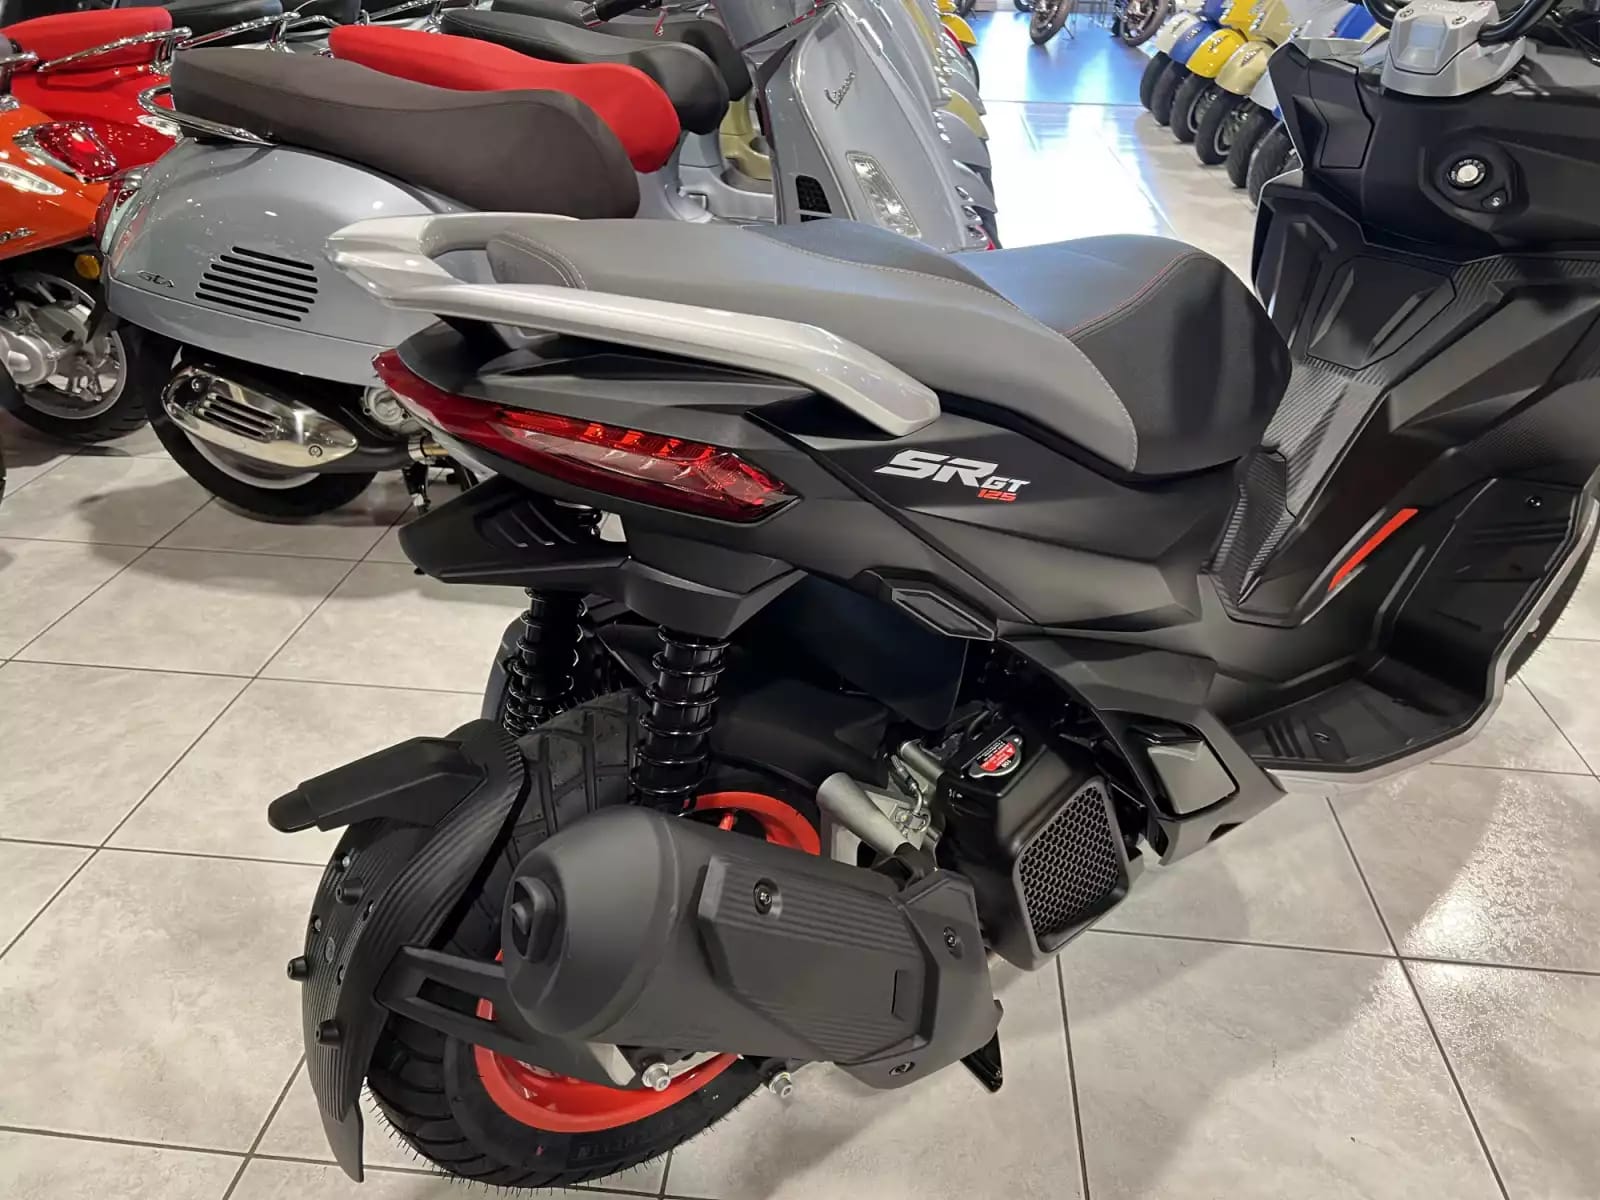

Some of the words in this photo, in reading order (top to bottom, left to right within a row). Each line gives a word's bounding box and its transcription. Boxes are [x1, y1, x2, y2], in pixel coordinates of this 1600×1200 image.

[874, 449, 999, 487] SR
[980, 475, 1031, 493] GT
[976, 487, 1017, 503] 125
